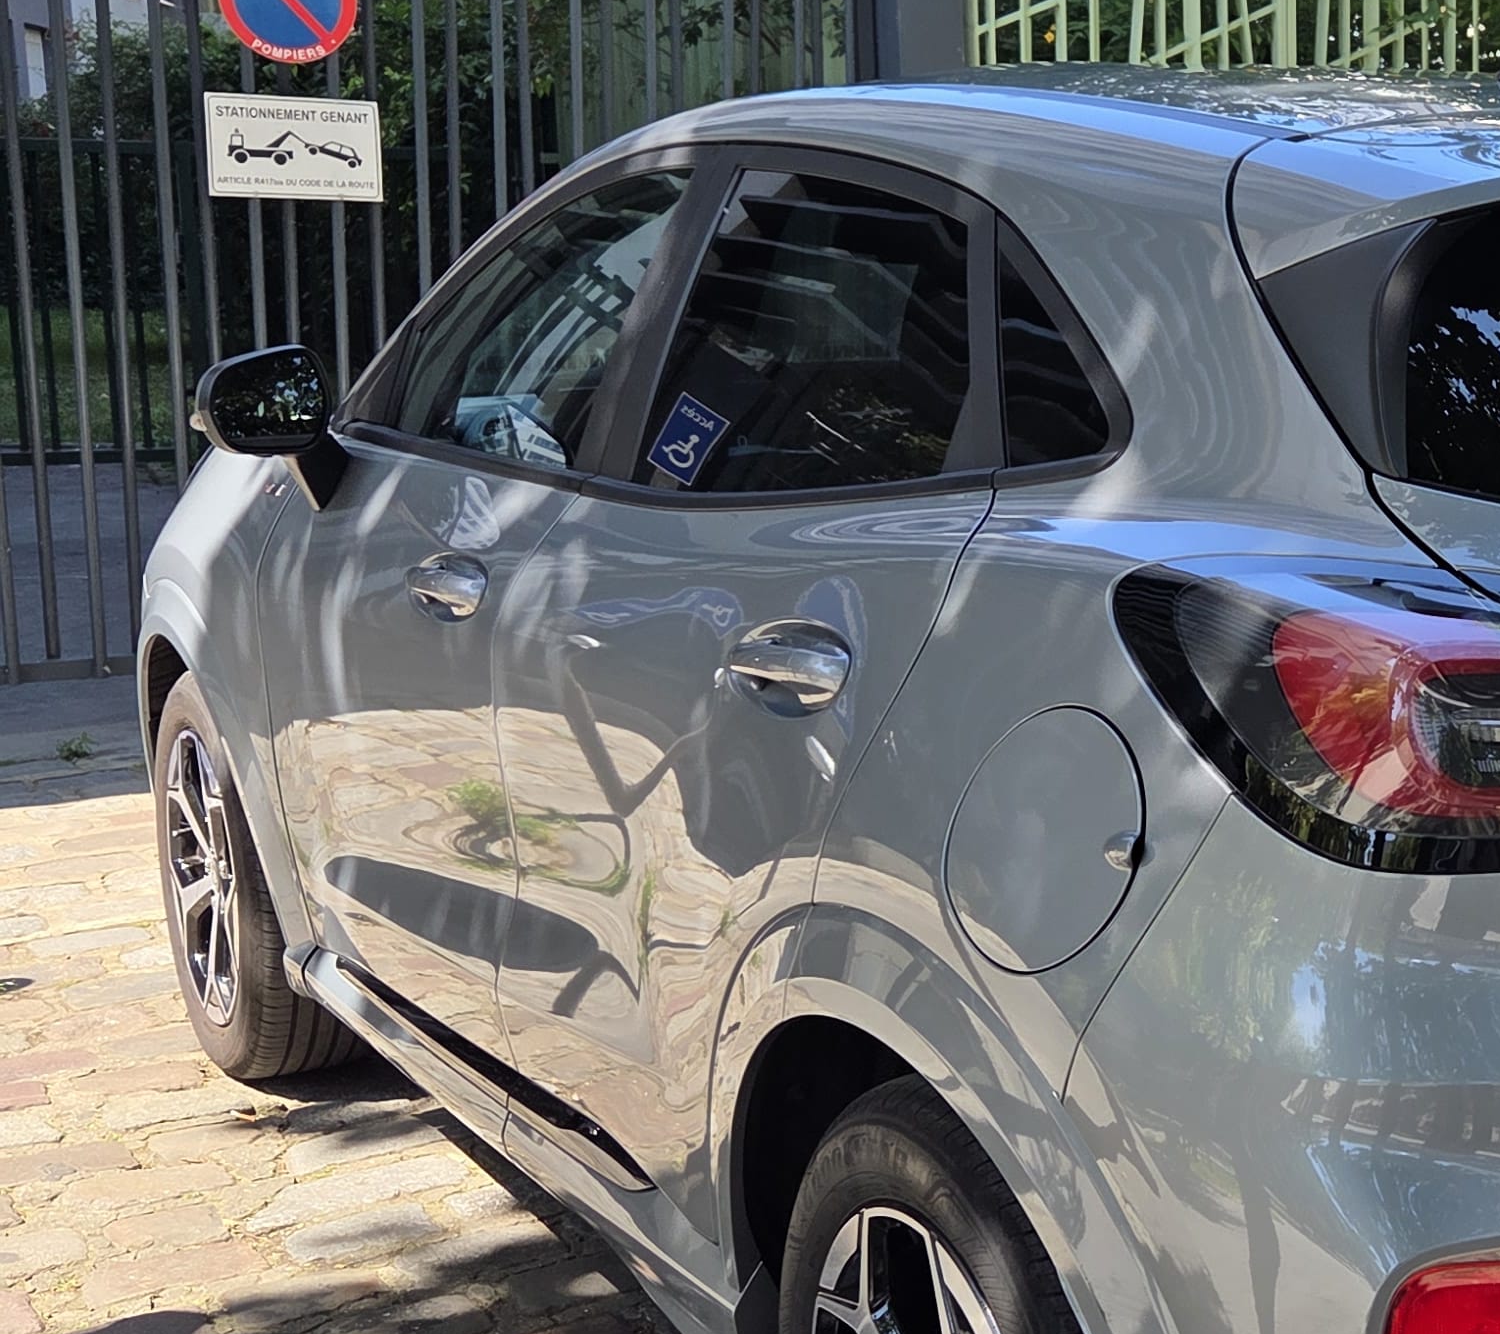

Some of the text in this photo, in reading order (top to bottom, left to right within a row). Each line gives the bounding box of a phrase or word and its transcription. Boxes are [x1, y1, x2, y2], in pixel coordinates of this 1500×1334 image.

[251, 38, 326, 60] POMPIERS
[215, 105, 369, 124] STATIONNEMENT GENANT
[217, 176, 252, 185] ARTICLE
[286, 179, 298, 187] DU
[299, 179, 321, 188] CODE
[323, 180, 335, 188] DE
[336, 180, 347, 188] LA
[348, 181, 375, 189] ROUTE
